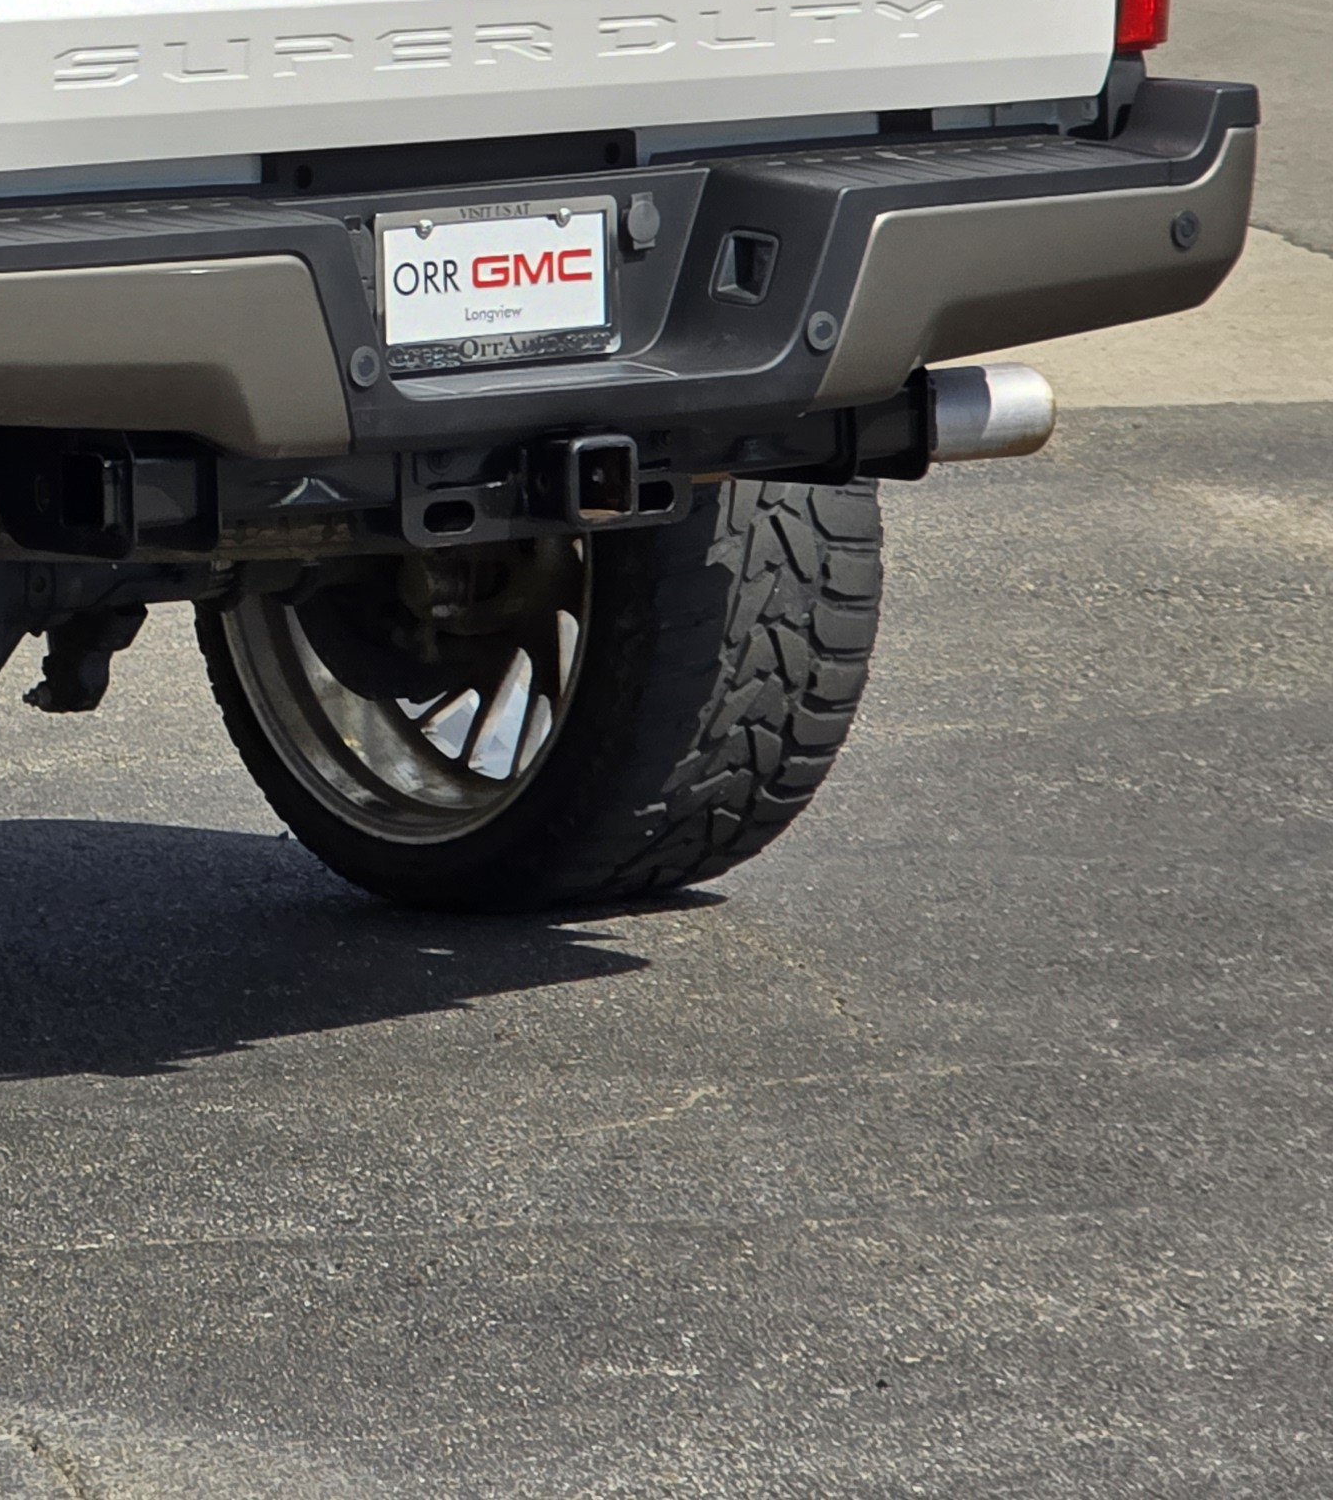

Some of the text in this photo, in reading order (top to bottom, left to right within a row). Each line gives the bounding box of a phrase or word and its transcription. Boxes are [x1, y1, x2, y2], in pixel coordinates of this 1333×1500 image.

[53, 21, 554, 90] SUPER
[393, 248, 592, 296] ORR GMC
[465, 305, 523, 323] Longview
